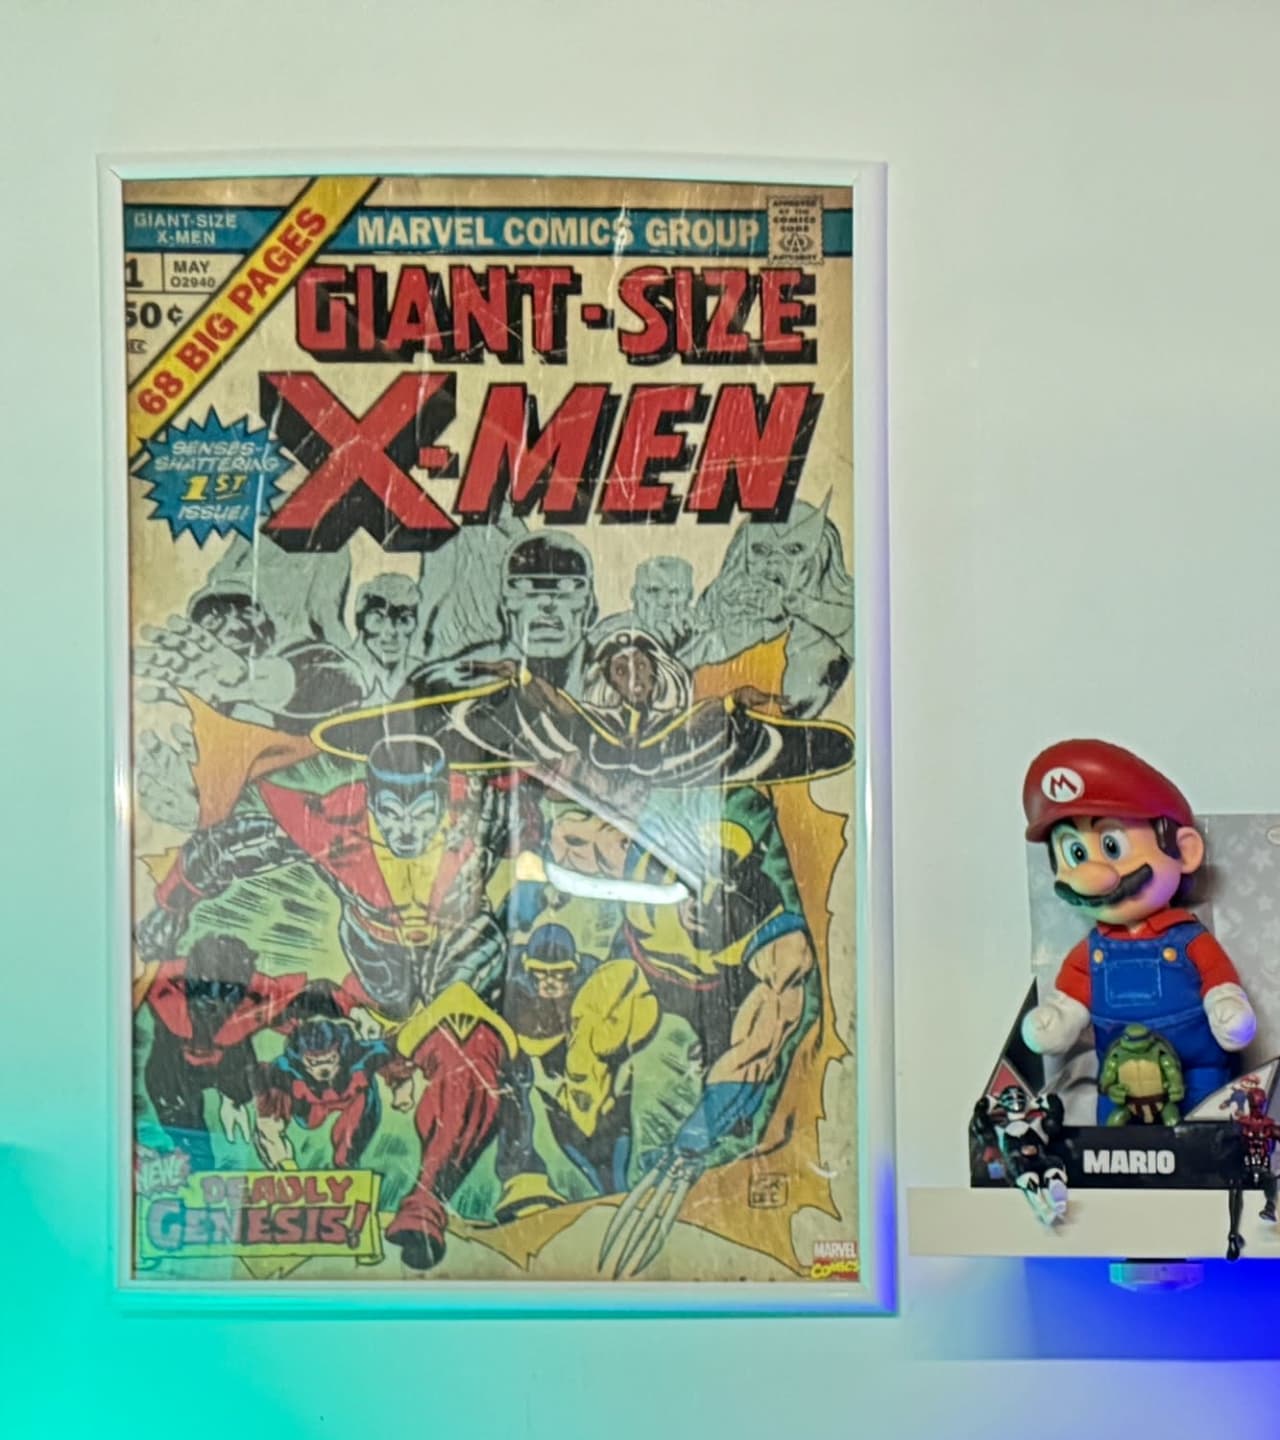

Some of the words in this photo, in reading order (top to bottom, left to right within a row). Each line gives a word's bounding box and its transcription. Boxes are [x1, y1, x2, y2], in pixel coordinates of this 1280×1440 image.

[133, 213, 237, 228] GIANT-SIZE
[357, 216, 496, 247] MARVEL
[503, 217, 633, 247] COMICS
[645, 218, 760, 248] GROUP
[157, 230, 216, 246] X-MEN
[125, 258, 143, 288] 1
[173, 260, 211, 274] MAY
[138, 370, 184, 416] 68
[174, 312, 239, 371] BIG
[227, 207, 327, 315] PAGES
[295, 264, 816, 364] GIANT-SIZE
[154, 456, 279, 472] SHATTERING
[259, 370, 823, 552] X-MEN
[177, 504, 250, 521] ISSUE!
[1051, 773, 1077, 798] M
[1083, 1149, 1175, 1174] MARIO
[201, 1176, 354, 1204] DEADLY
[146, 1199, 371, 1250] GENESIS!
[814, 1242, 857, 1259] MARVEL
[811, 1261, 859, 1279] COMICS
